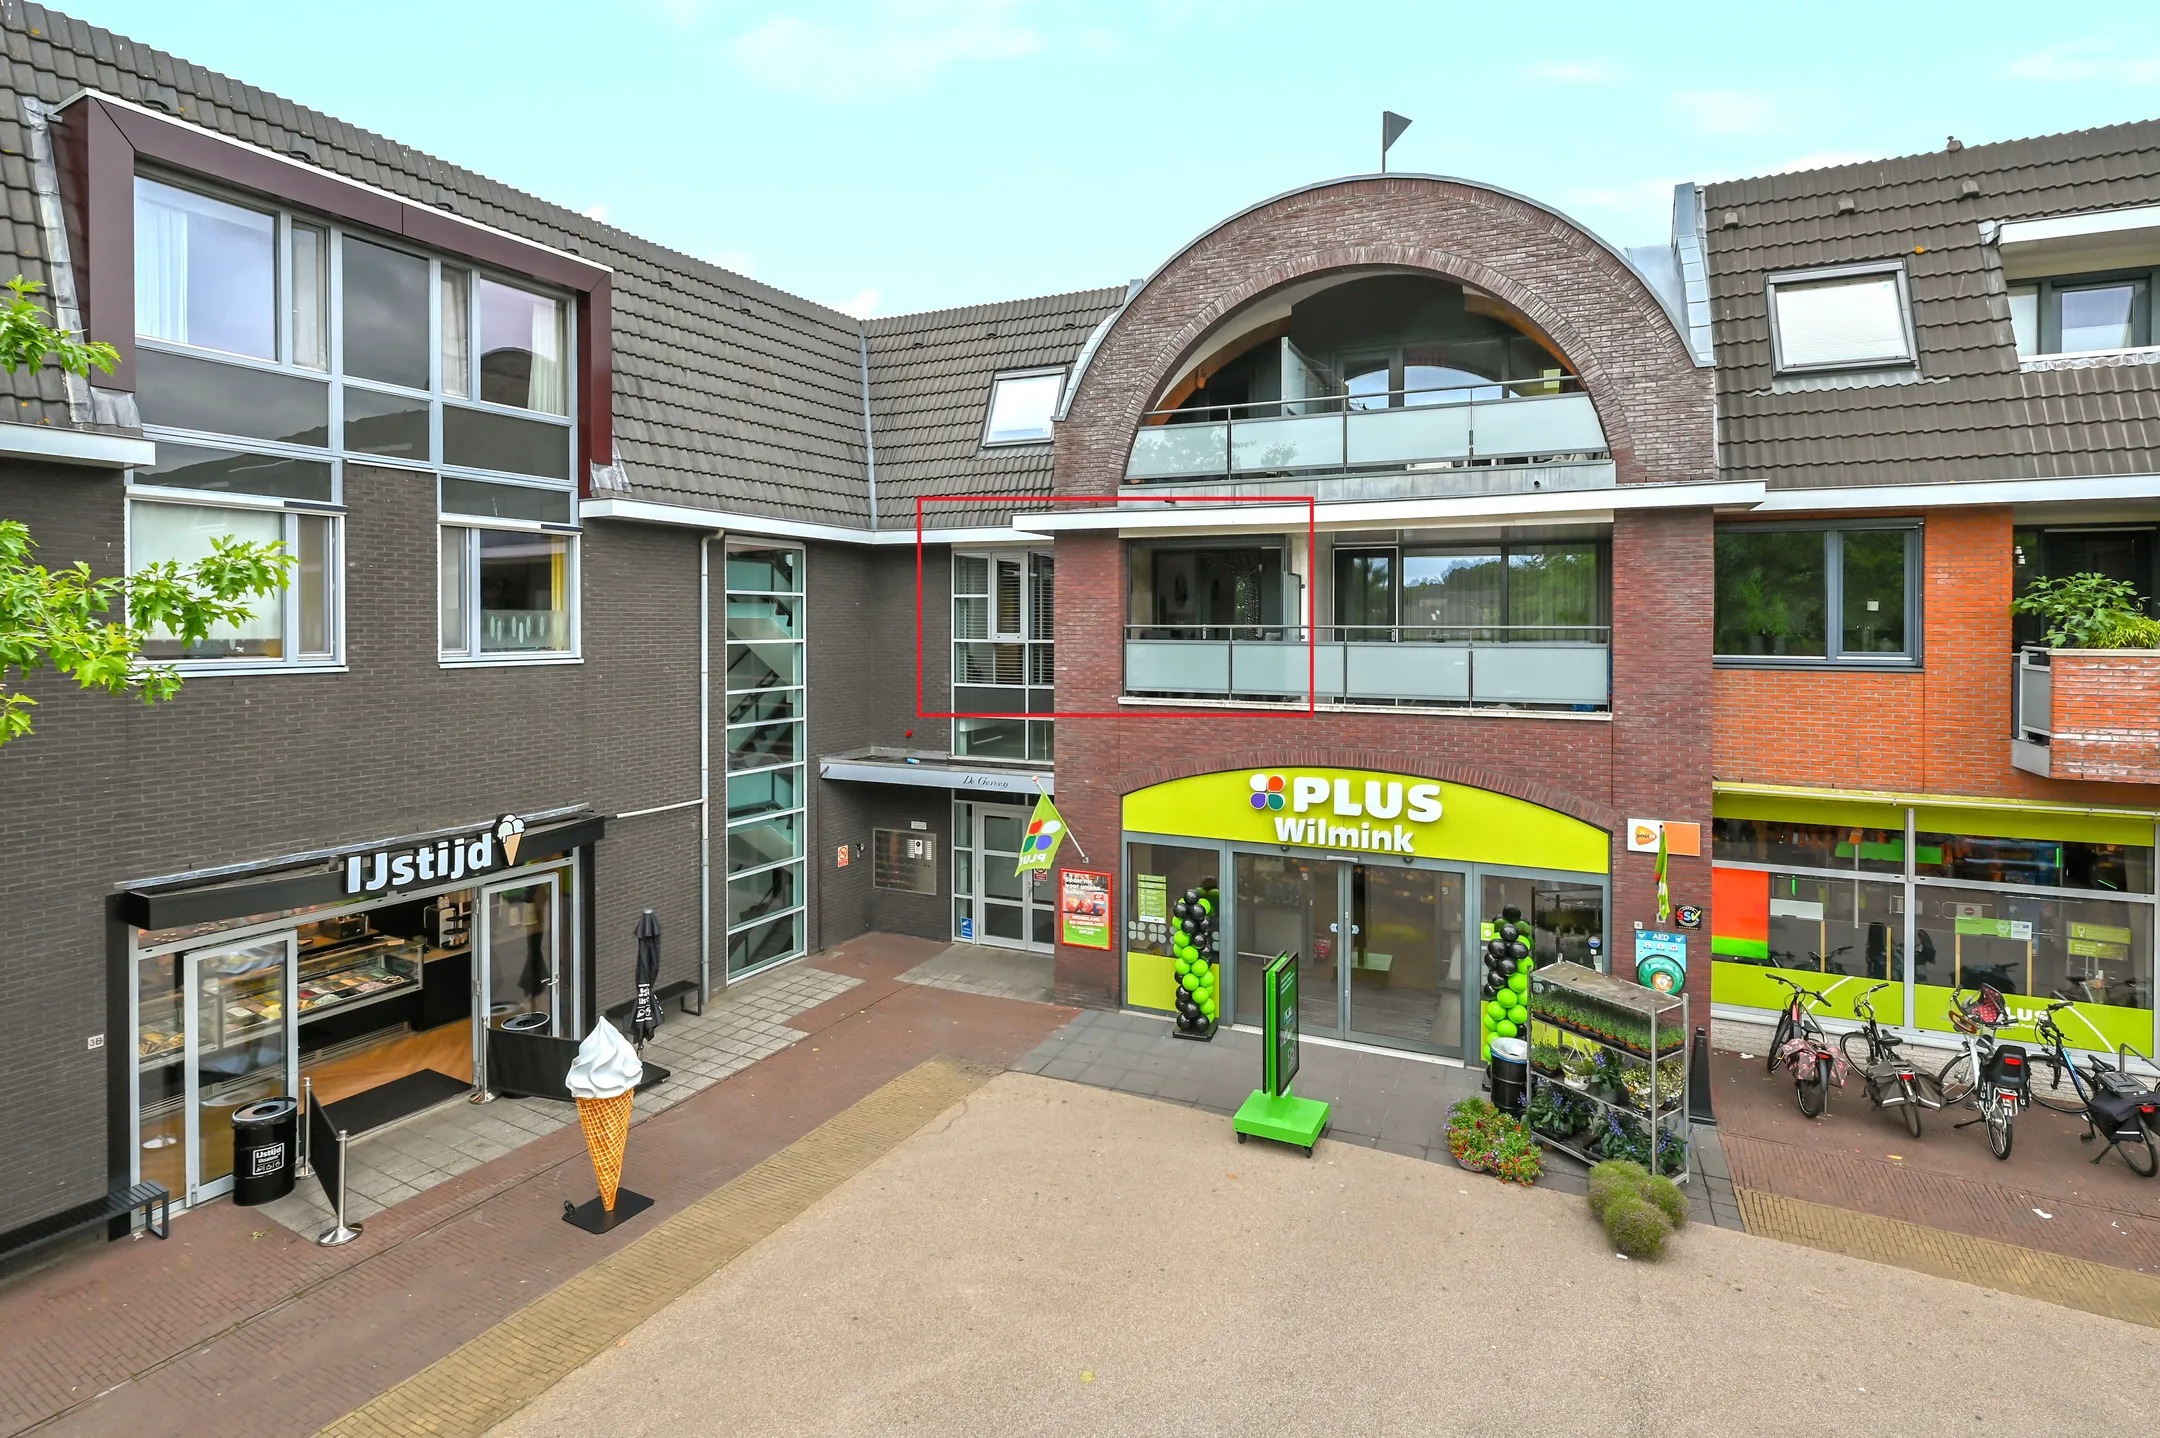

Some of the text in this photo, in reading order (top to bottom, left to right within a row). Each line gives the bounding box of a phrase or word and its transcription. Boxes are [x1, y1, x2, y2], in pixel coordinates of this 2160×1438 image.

[1294, 777, 1442, 822] PLUS
[1274, 816, 1415, 853] Wilmink
[347, 832, 493, 894] IJstijd
[1652, 933, 1669, 941] AED
[90, 1038, 102, 1046] 3B
